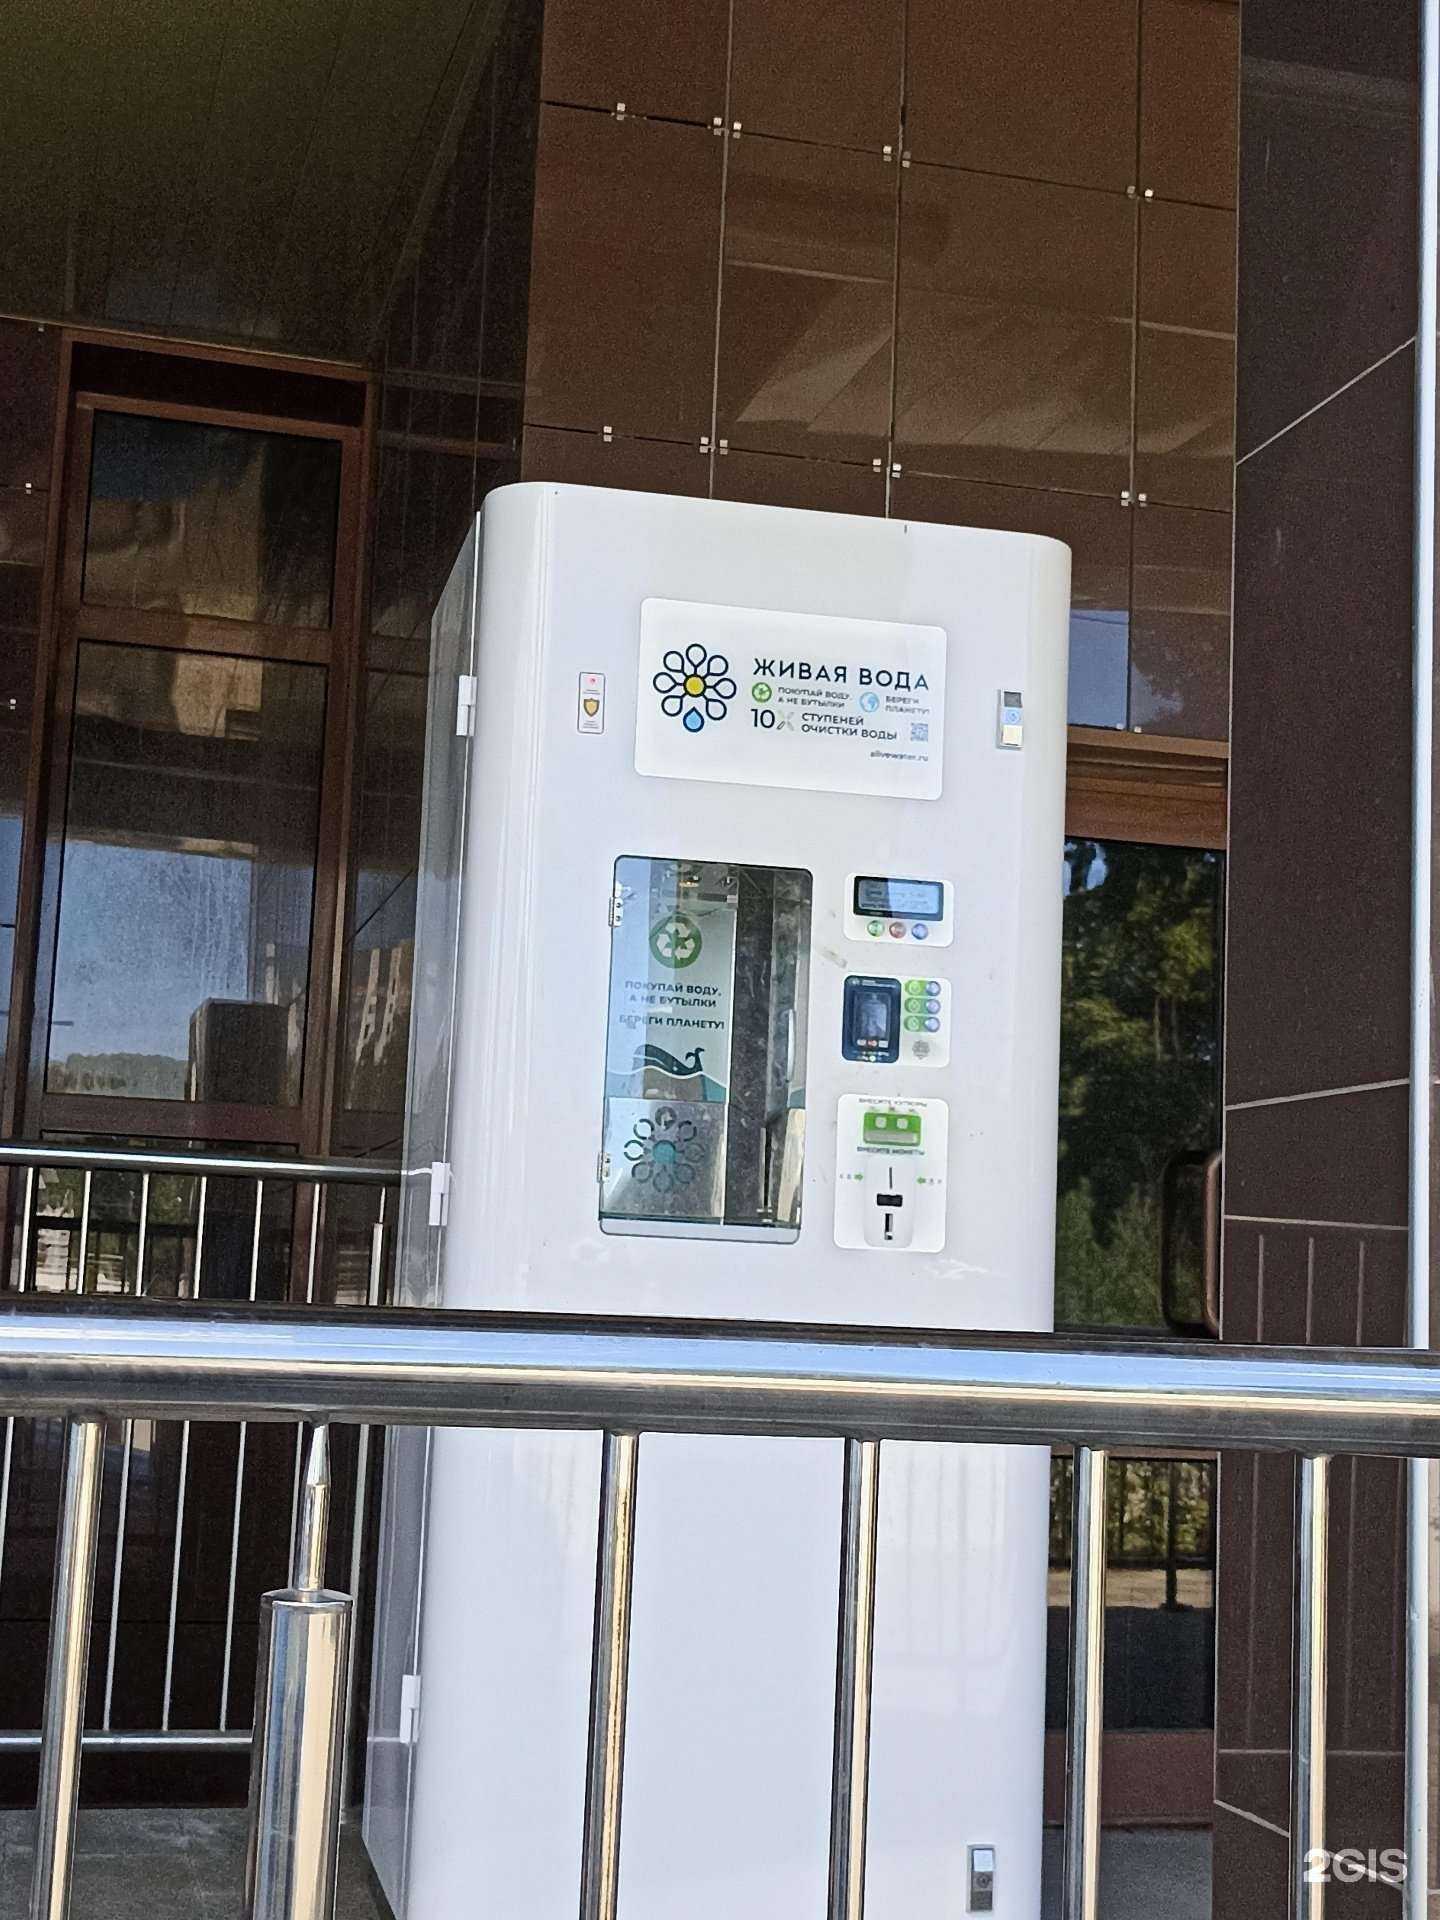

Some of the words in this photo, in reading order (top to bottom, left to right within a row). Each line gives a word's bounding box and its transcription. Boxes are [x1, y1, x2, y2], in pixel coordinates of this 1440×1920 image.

[753, 658, 847, 683] ЖИВАЯ
[859, 668, 929, 691] ВОДА
[778, 686, 823, 697] ПОКУПАЙ
[801, 699, 845, 709] БУТЫЛКИ
[885, 695, 920, 704] БЕРЕГИ
[751, 708, 776, 729] 10
[801, 712, 864, 726] СТУПЕНЕЙ
[801, 724, 858, 737] ОЧИСТКИ
[861, 729, 897, 741] ВОДЫ
[625, 980, 683, 992] ПОКУПАЙ
[641, 995, 655, 1004] НЕ
[660, 996, 716, 1008] БУТЫЛКИ
[666, 1018, 725, 1030] ПЛАНЕТУ!
